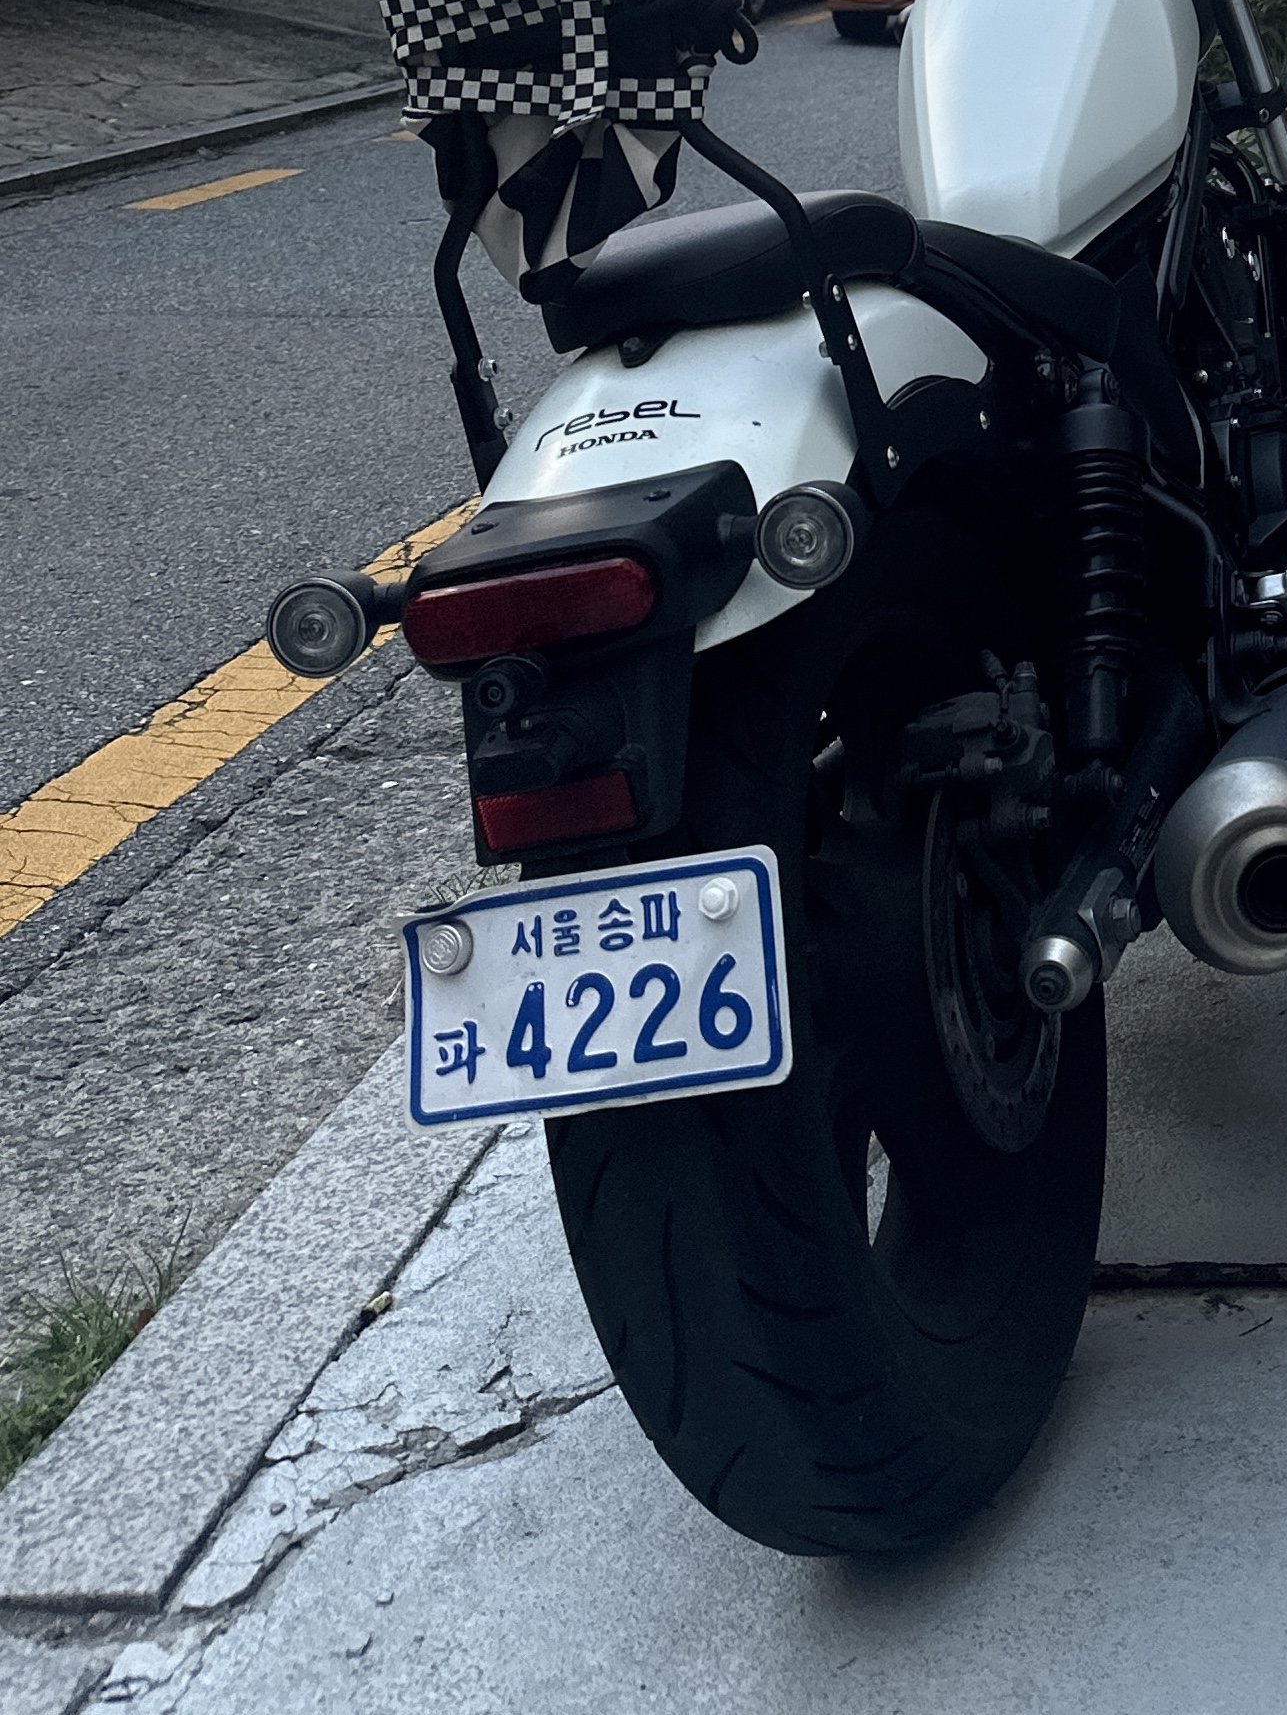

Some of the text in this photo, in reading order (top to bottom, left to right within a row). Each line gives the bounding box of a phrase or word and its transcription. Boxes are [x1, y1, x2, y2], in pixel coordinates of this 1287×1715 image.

[557, 429, 659, 459] HONDA
[511, 890, 682, 958] 서울 송파
[433, 952, 753, 1085] 파 4226
